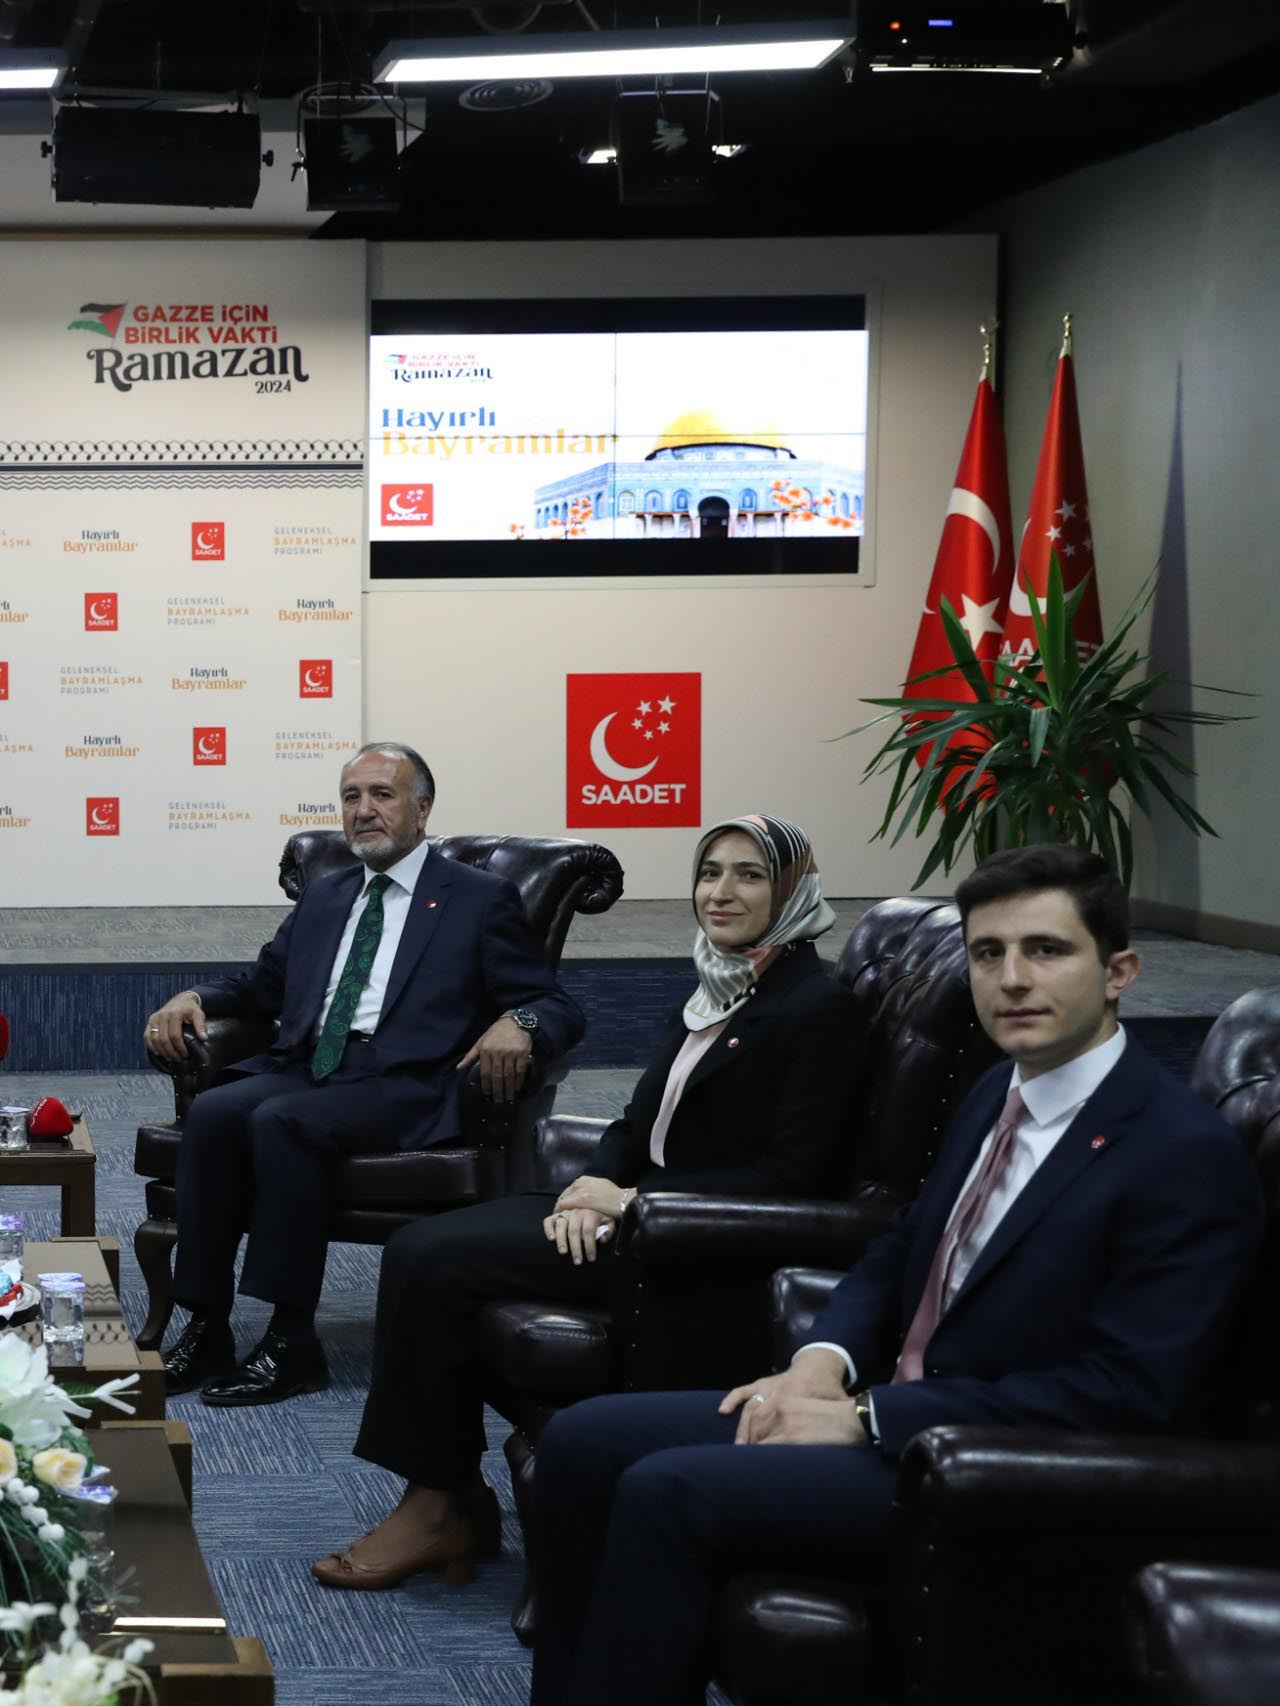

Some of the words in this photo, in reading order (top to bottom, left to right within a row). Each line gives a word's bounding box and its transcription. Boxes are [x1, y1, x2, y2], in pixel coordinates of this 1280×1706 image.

[133, 304, 214, 323] GAZZE
[86, 344, 309, 392] Ramazan
[254, 379, 292, 394] 2024
[382, 407, 496, 432] Hayırlı
[382, 428, 620, 461] Bayramlar
[63, 540, 140, 555] Bayramlar
[278, 610, 355, 624] Bayramlar
[172, 678, 248, 692] Bayramlar
[65, 746, 141, 760] Bayramlar
[581, 783, 686, 805] SAADET
